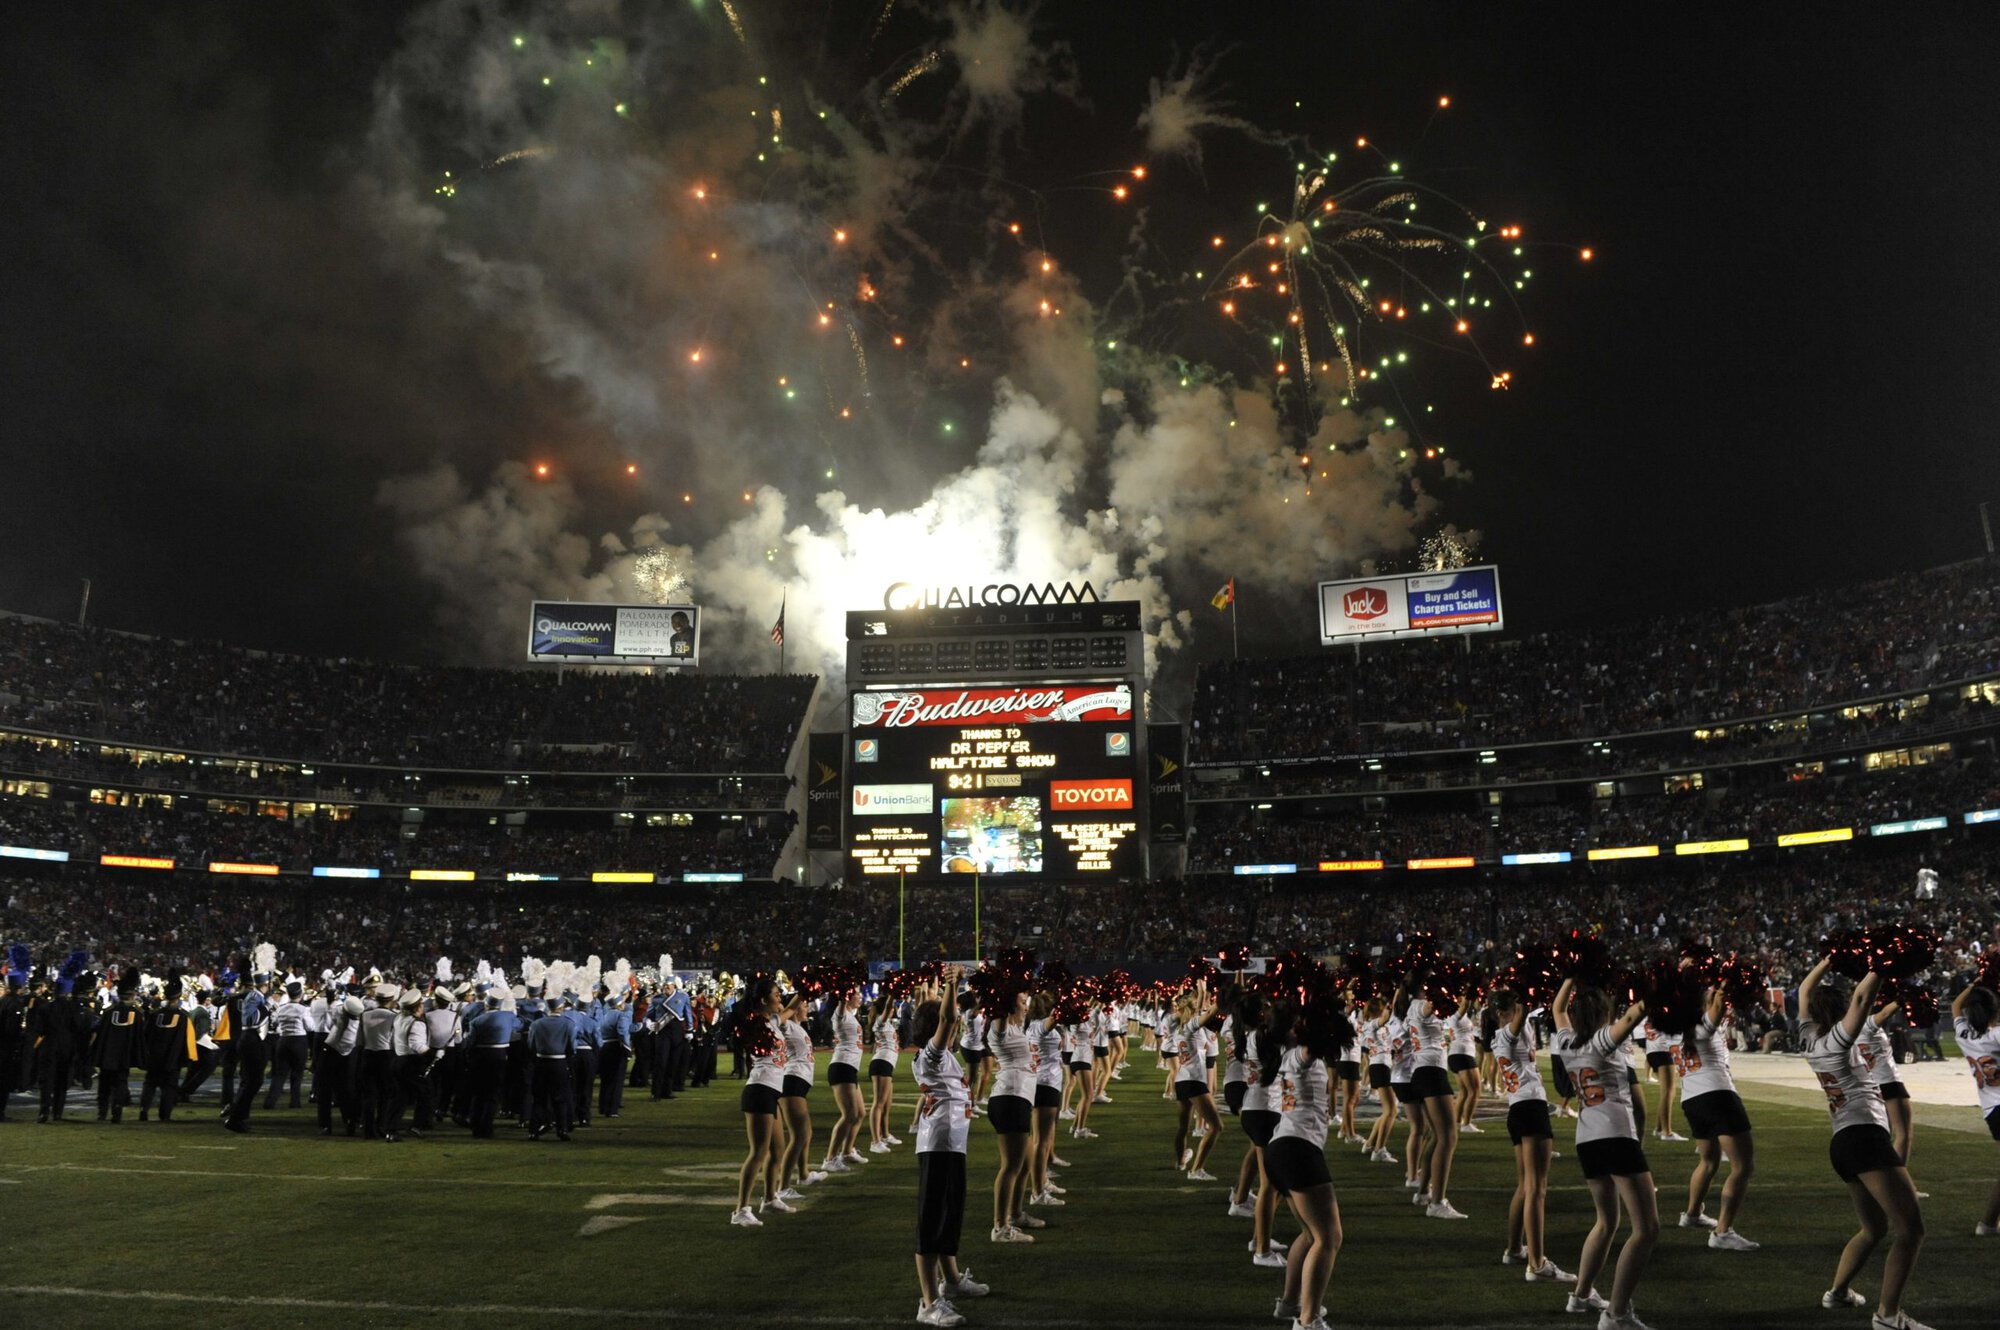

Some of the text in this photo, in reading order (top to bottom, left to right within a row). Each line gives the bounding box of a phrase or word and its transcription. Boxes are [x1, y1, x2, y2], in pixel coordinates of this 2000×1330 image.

[884, 581, 1100, 611] QUALCOMM
[1424, 589, 1478, 604] Buy and Sell
[1345, 590, 1387, 617] Jack
[1414, 599, 1491, 615] Chargers Tickets!
[620, 611, 670, 620] PALOMAR
[927, 611, 1083, 625] STADIUM
[537, 619, 612, 635] QUALCOMM
[619, 620, 670, 629] POMERADO
[1371, 621, 1386, 629] box
[619, 629, 669, 638] HEALTH
[623, 646, 665, 654] www.pph.org
[877, 688, 1064, 728] Budweiser
[1066, 698, 1103, 716] American
[1105, 696, 1129, 705] Lager
[960, 728, 1021, 740] THANKS TO
[951, 742, 971, 754] DR
[1016, 754, 1056, 768] SHOW
[809, 789, 840, 802] Sprint
[1054, 788, 1129, 803] TOYOTA
[1150, 783, 1183, 796] Sprint
[873, 795, 932, 805] UnionBank
[1071, 823, 1110, 832] PACIFIC
[1113, 823, 1136, 831] LIFE
